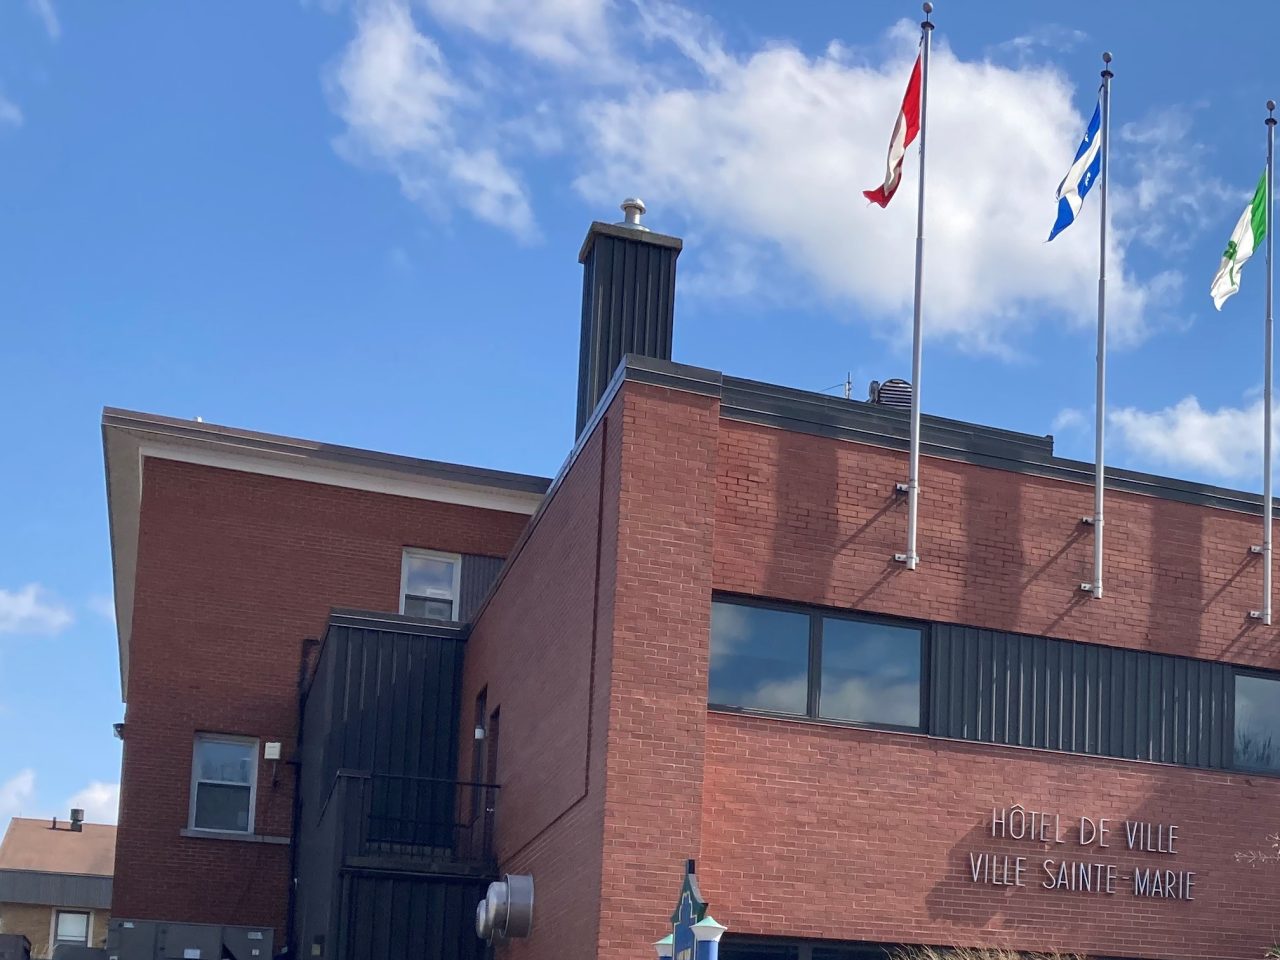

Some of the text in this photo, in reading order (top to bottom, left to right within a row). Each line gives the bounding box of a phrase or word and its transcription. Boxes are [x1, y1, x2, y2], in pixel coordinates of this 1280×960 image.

[992, 803, 1179, 854] HÔTEL DE VILLE
[970, 852, 1027, 887] VILLE
